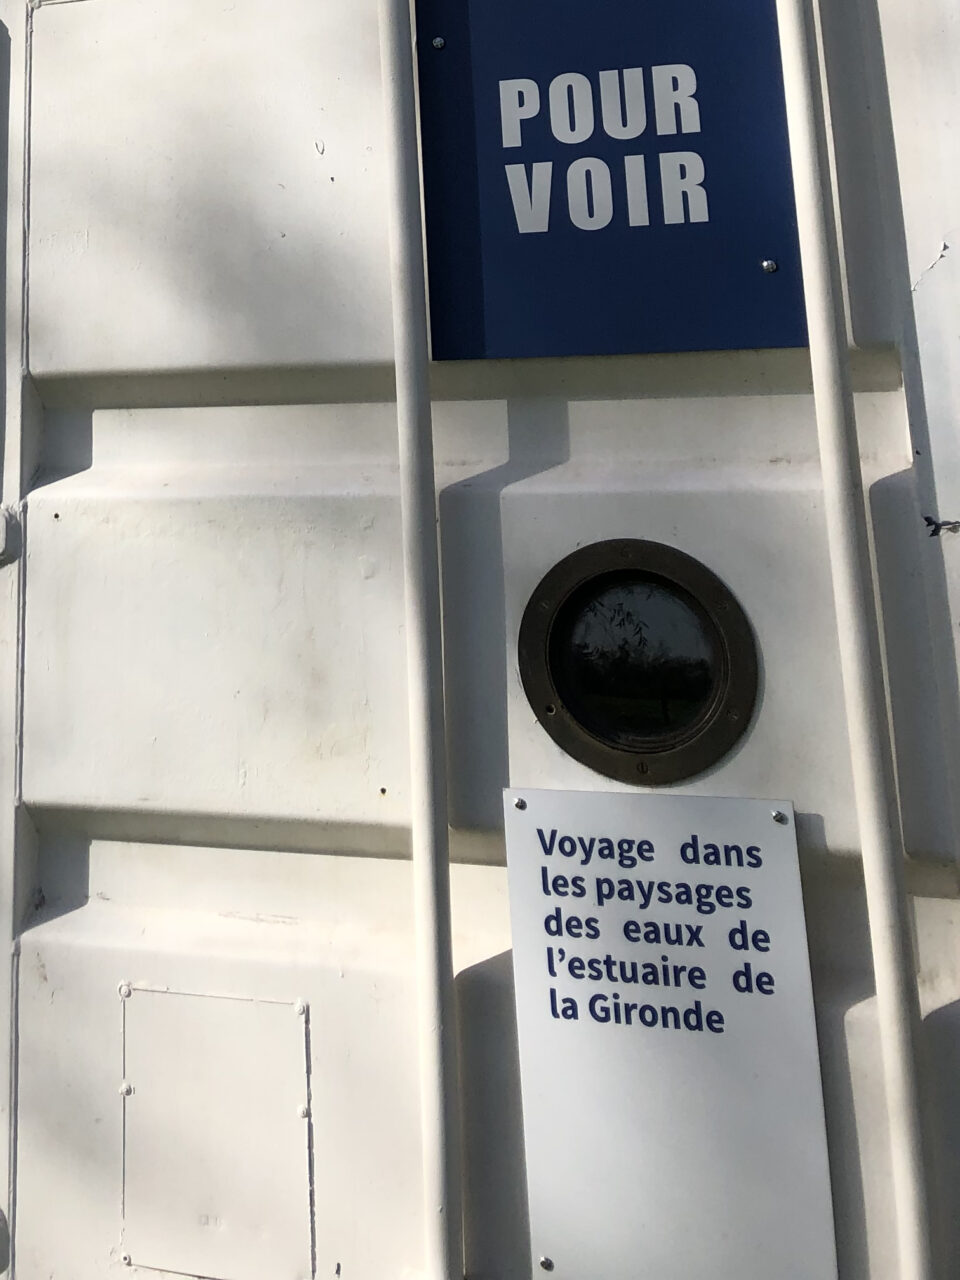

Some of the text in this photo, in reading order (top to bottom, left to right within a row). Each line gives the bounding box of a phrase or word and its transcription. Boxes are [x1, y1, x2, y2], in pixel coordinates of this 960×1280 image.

[499, 64, 700, 147] POUR
[505, 152, 708, 233] VOIR
[536, 828, 762, 868] Voyage dans
[541, 866, 752, 914] les paysages
[544, 907, 770, 952] des eaux de
[733, 963, 774, 995] de
[550, 988, 724, 1033] la Gironde
